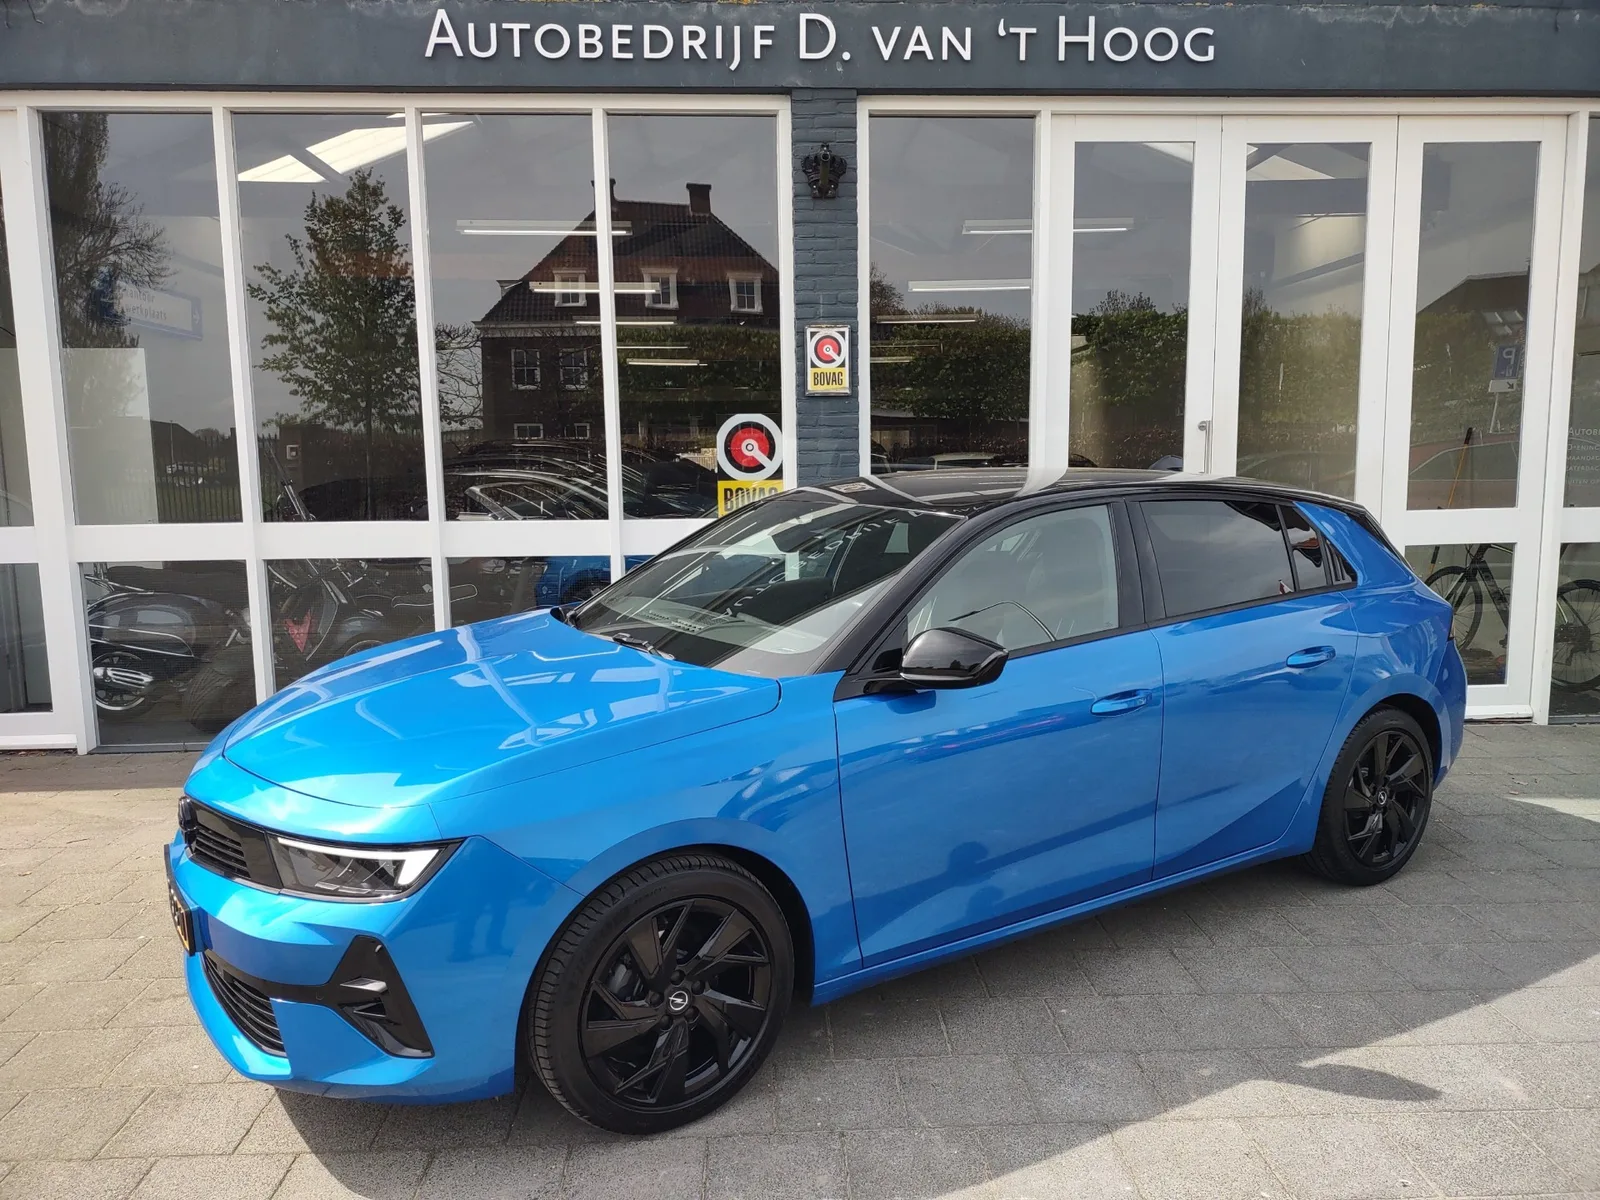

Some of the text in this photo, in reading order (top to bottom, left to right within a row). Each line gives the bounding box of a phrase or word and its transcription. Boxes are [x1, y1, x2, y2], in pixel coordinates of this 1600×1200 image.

[424, 8, 776, 72] AUTOBEDRIJF
[799, 13, 852, 61] D.
[871, 25, 972, 61] VAN
[1058, 15, 1216, 62] HOOG
[813, 371, 843, 386] BOVAG
